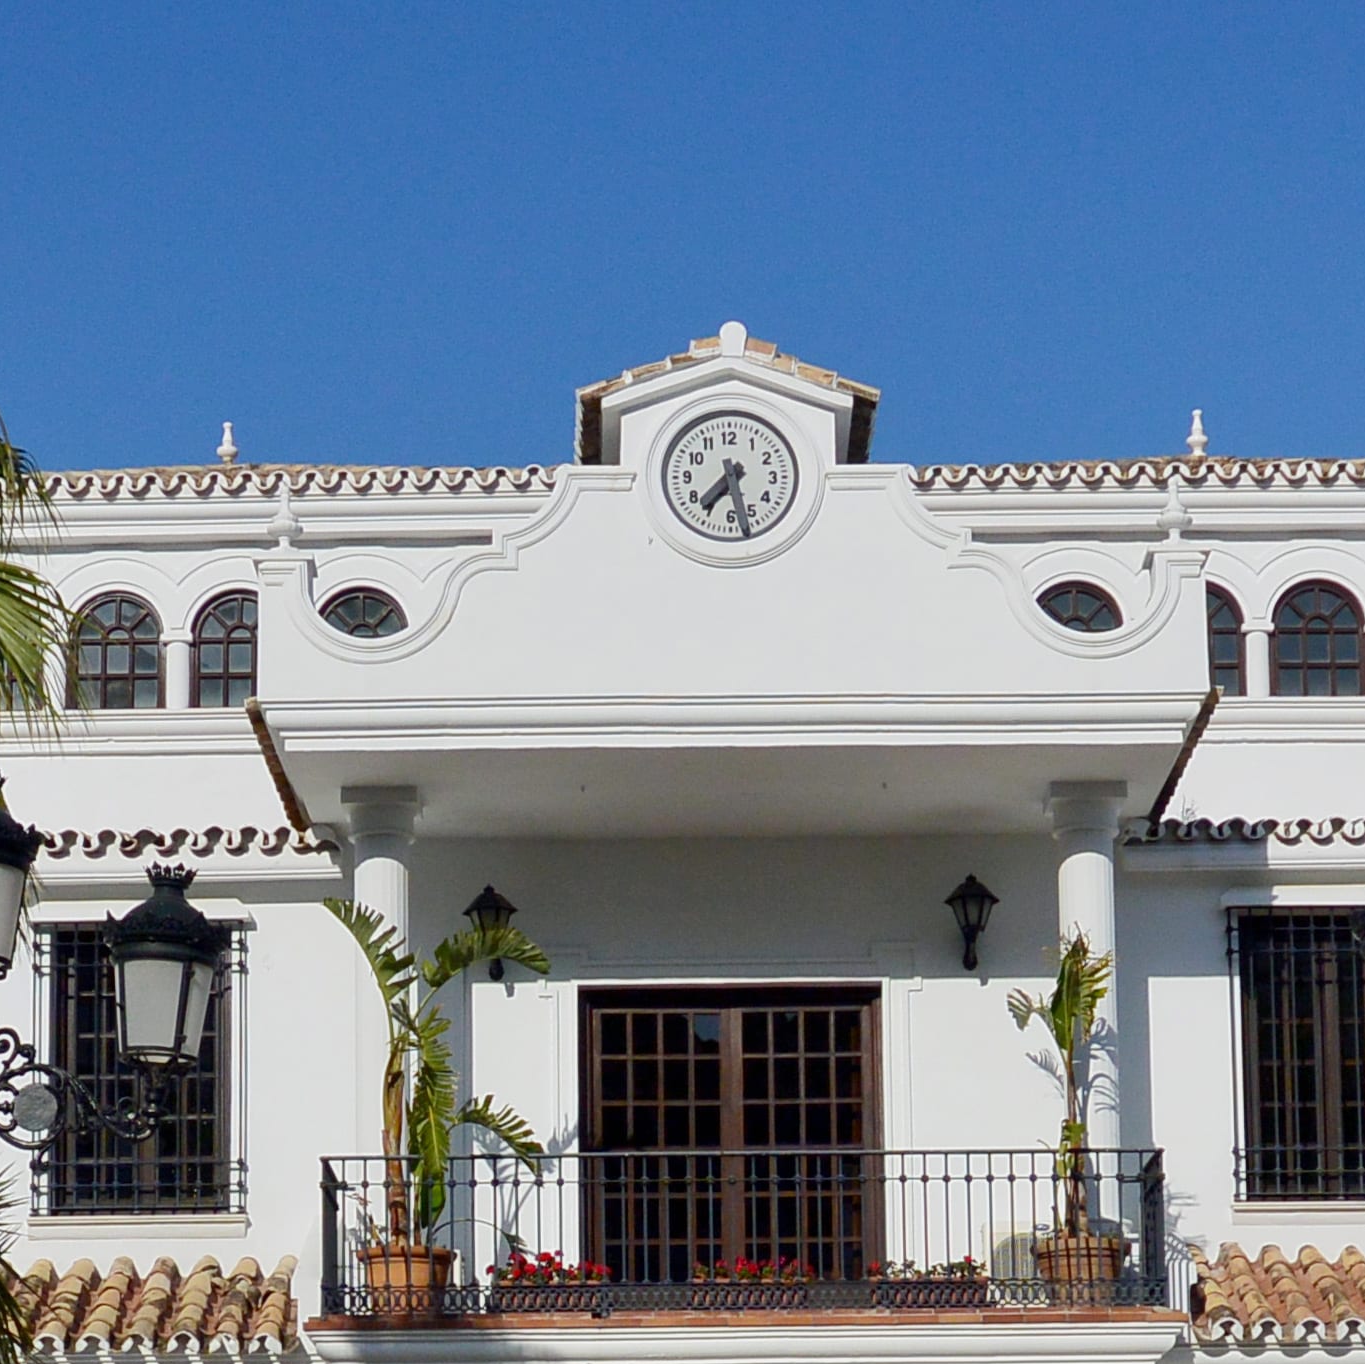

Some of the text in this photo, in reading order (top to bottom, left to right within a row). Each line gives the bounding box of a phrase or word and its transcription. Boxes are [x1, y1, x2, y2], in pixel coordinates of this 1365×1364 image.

[702, 436, 714, 451] 11
[721, 431, 737, 445] 12
[749, 437, 755, 451] 1
[689, 451, 704, 465] 10
[762, 451, 772, 465] 2
[683, 470, 692, 484] 9
[768, 471, 778, 484] 3
[689, 490, 698, 504] 8
[760, 490, 770, 503] 4
[726, 510, 736, 524] 6
[747, 504, 757, 517] 5
